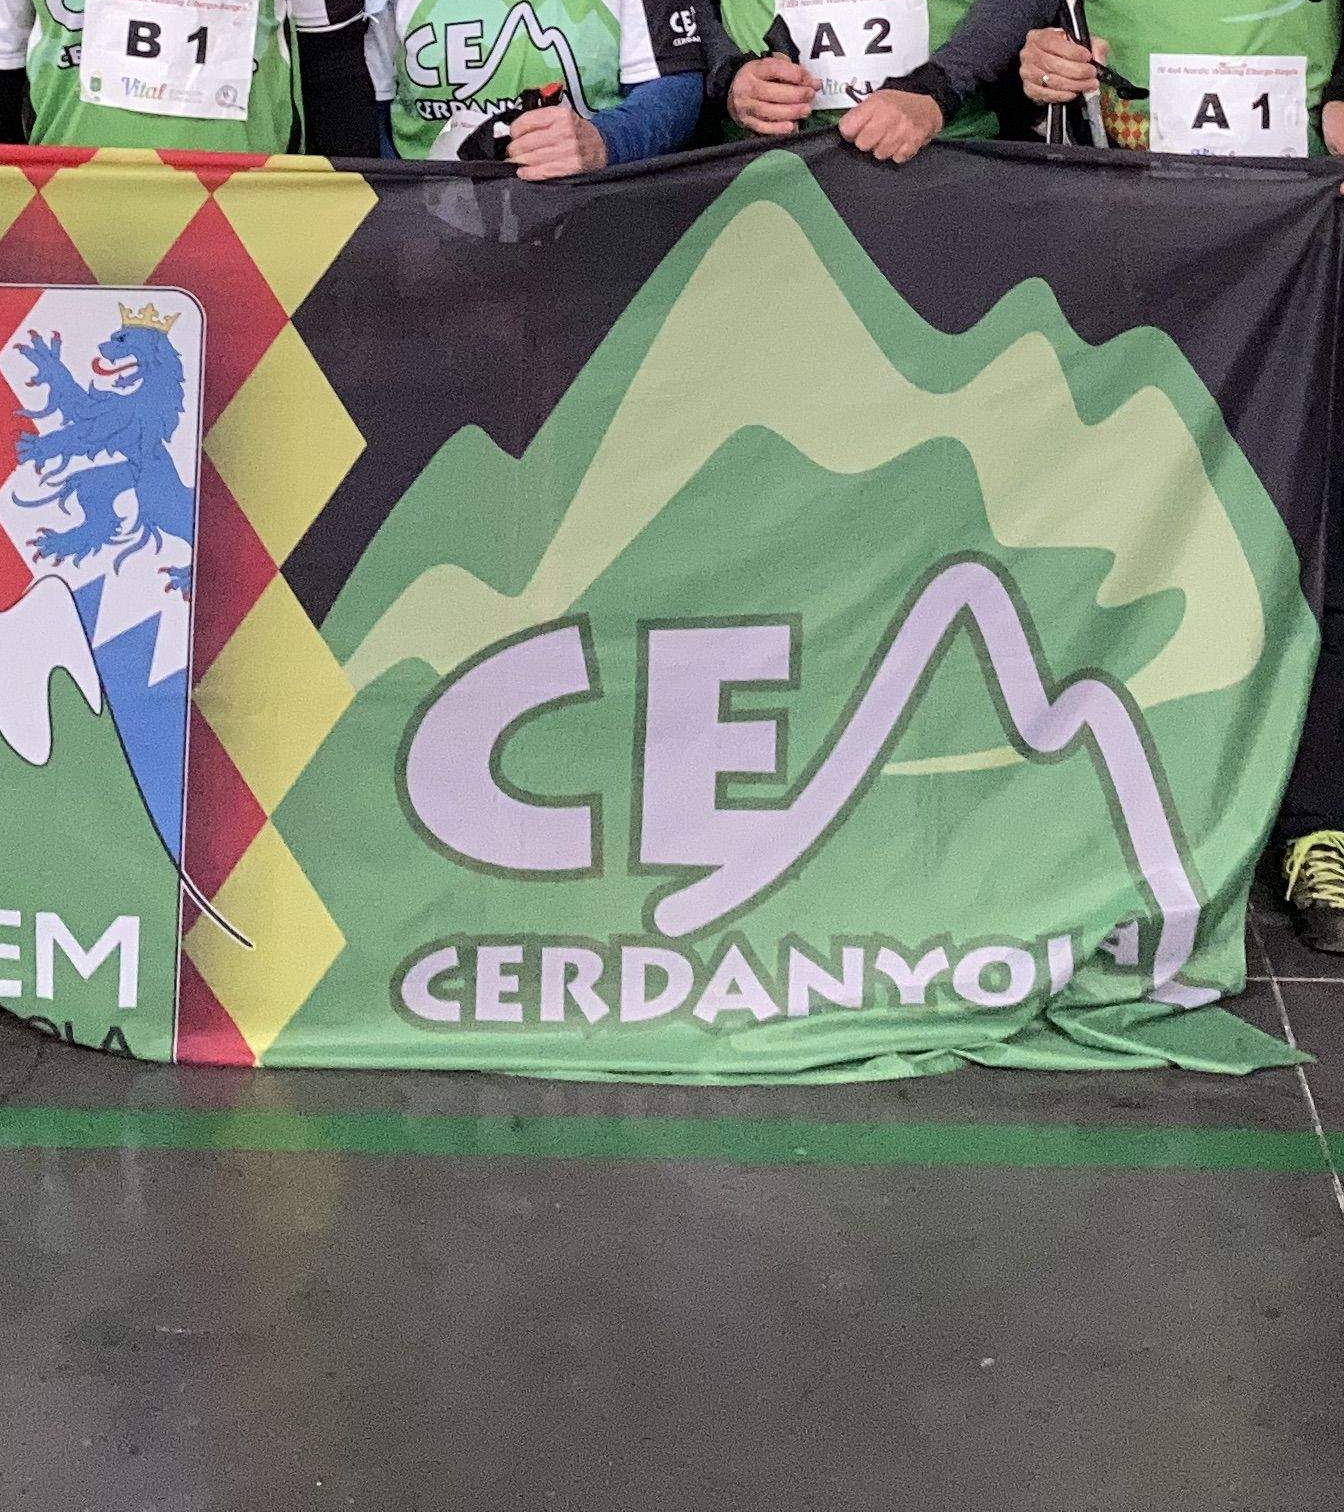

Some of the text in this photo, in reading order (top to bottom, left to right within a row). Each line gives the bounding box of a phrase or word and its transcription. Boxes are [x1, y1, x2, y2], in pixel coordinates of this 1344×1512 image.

[126, 18, 162, 59] B
[187, 25, 209, 64] 1
[808, 17, 895, 61] A 2
[1191, 92, 1271, 130] A 1
